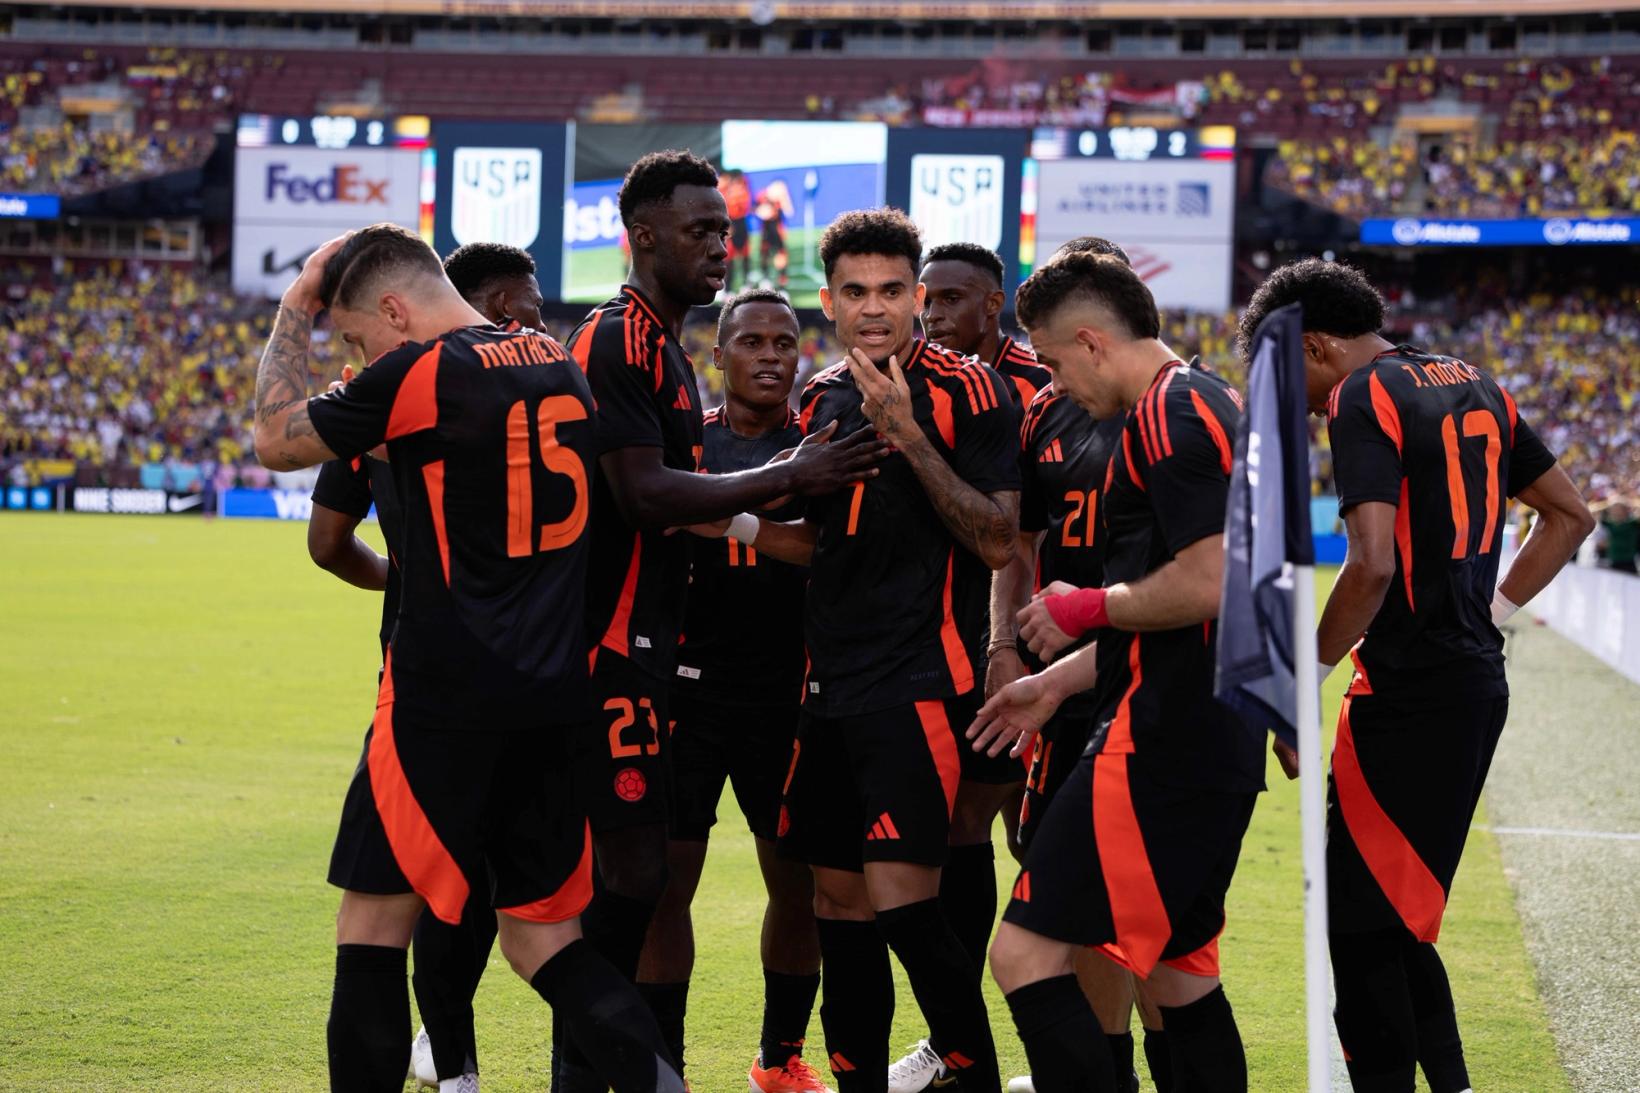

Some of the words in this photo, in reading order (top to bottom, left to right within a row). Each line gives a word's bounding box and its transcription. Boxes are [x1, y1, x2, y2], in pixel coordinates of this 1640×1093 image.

[265, 163, 390, 205] FedEx
[461, 158, 531, 199] USA
[919, 165, 993, 208] USA
[472, 334, 569, 369] MATHEU
[506, 394, 589, 558] 15
[1441, 409, 1502, 560] 17
[1061, 488, 1099, 548] 21
[603, 697, 660, 759] 23
